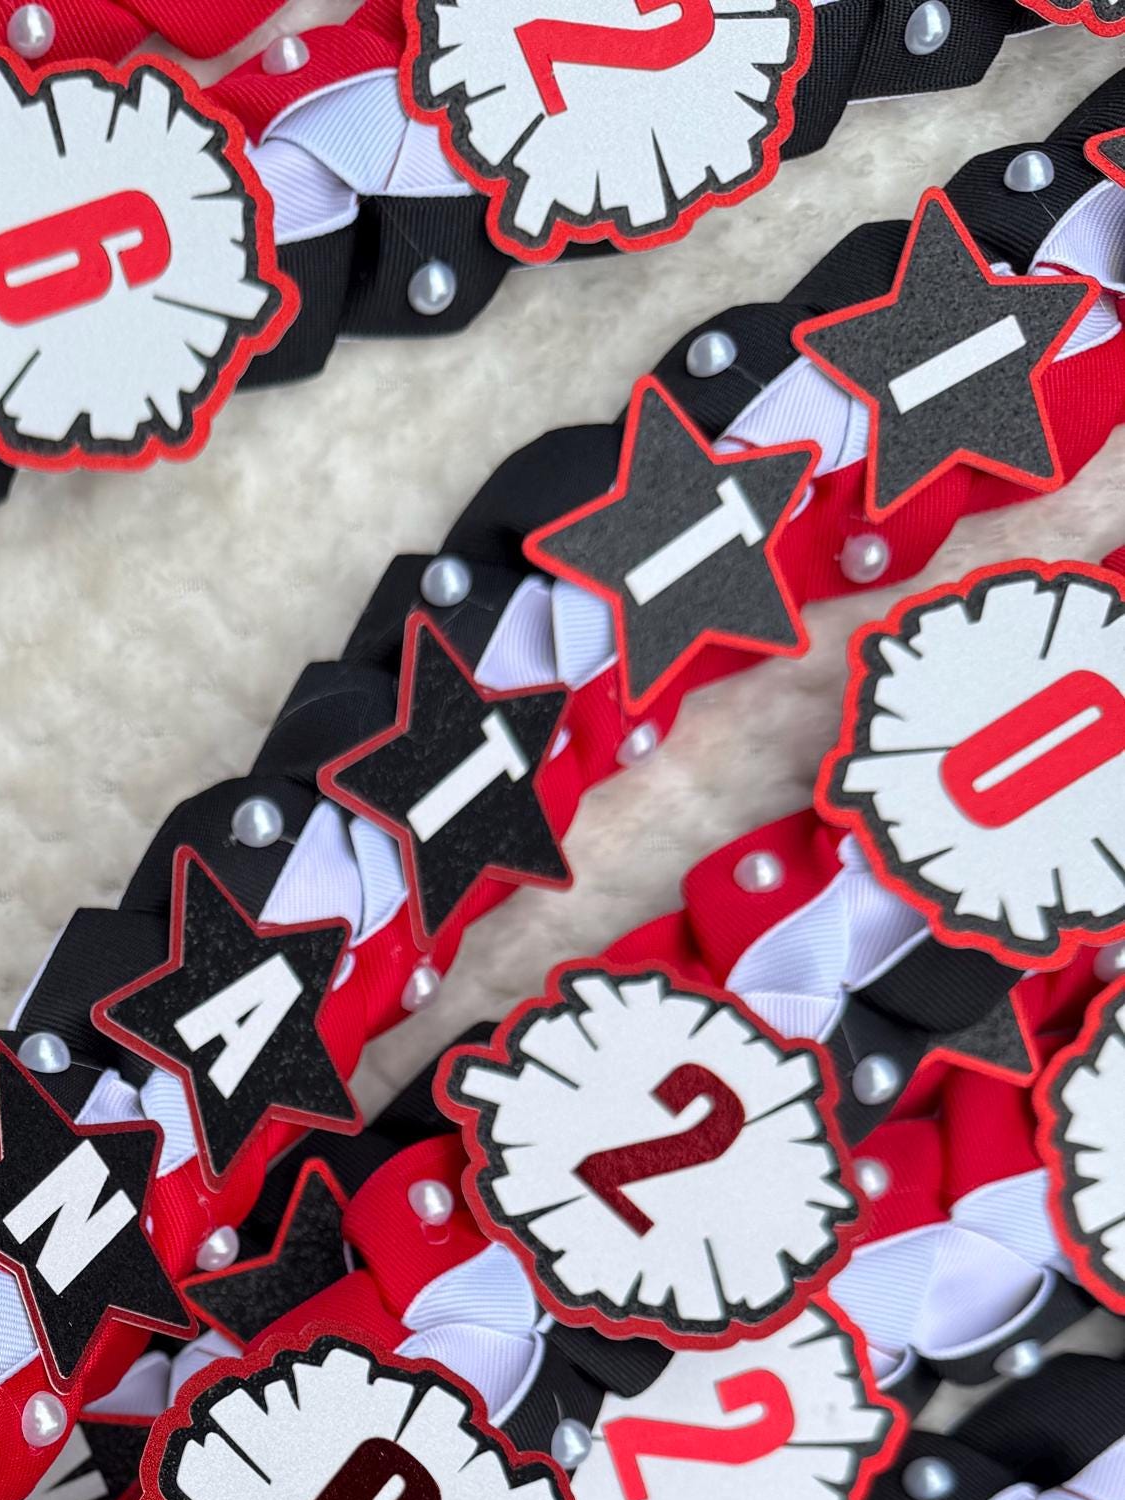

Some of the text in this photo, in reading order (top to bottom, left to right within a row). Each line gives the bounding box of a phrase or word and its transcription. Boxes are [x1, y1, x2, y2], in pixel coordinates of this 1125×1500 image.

[624, 477, 763, 606] T
[406, 709, 529, 844] T
[174, 955, 304, 1100] A
[2, 1139, 138, 1296] N
[575, 1062, 745, 1238] 2
